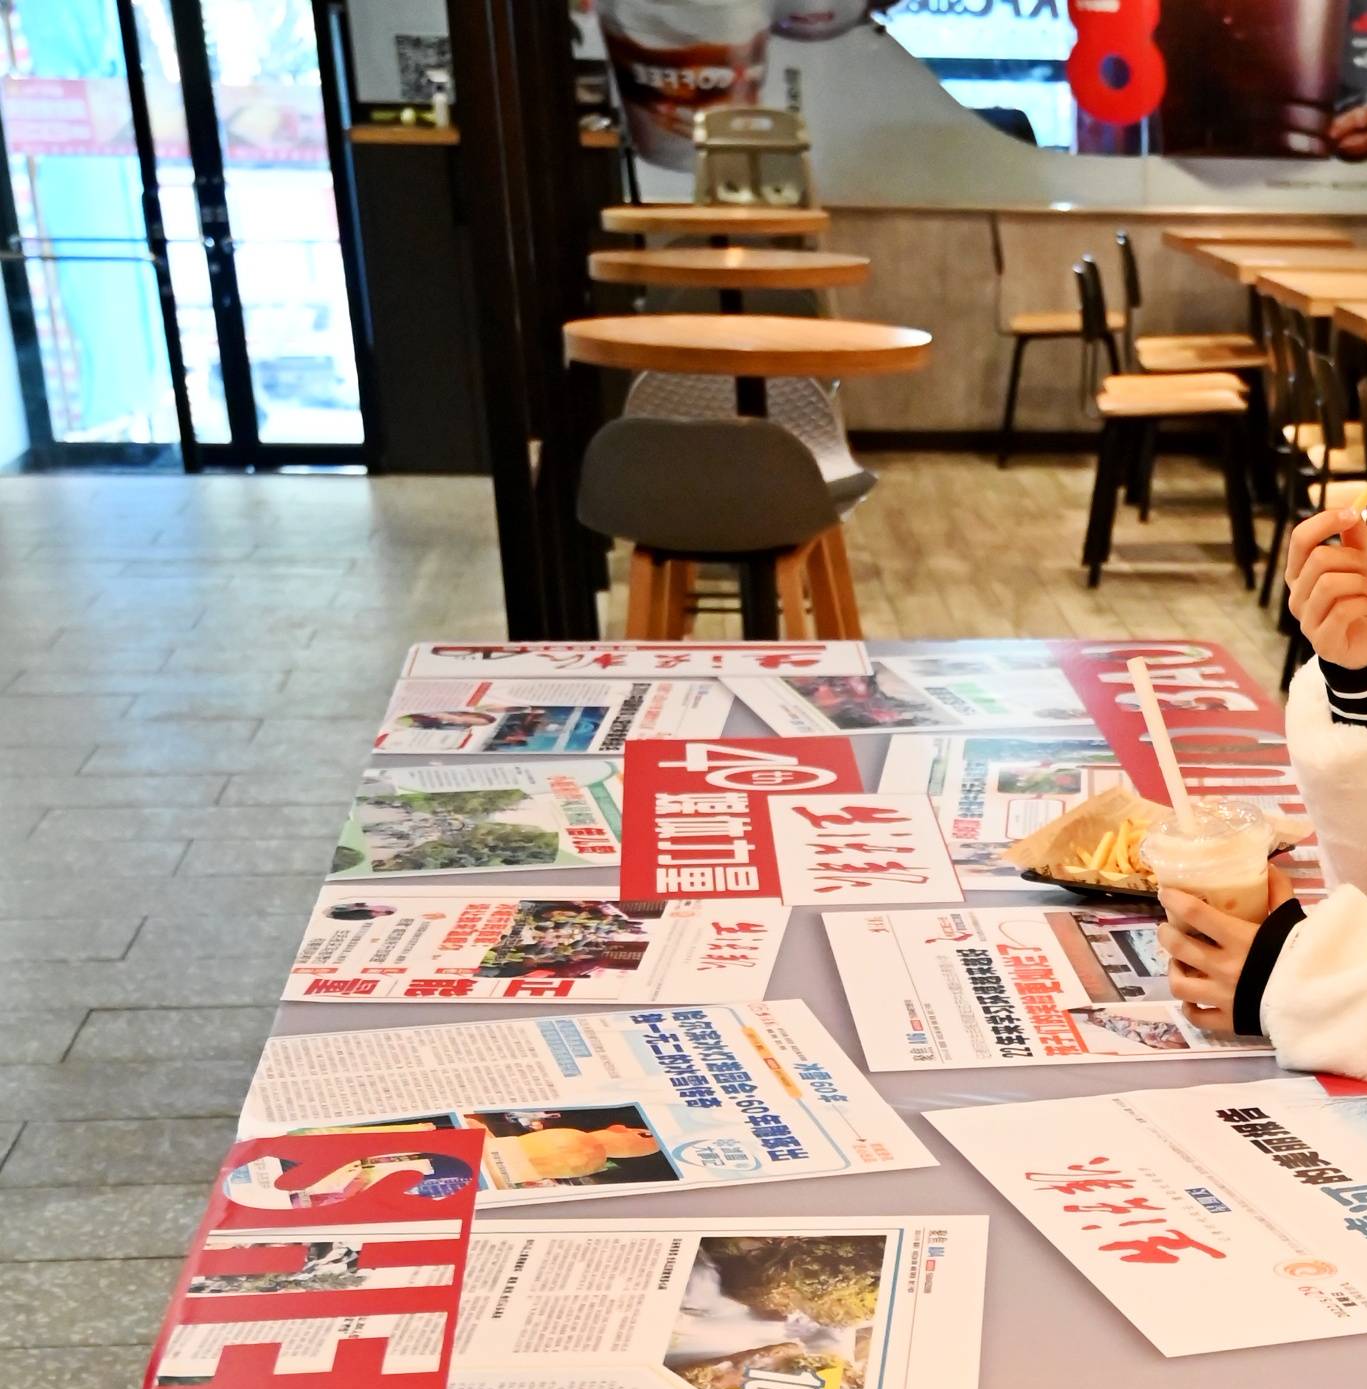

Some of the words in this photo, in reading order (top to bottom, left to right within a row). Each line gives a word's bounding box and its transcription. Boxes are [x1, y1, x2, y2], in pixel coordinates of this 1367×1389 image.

[654, 791, 760, 895] 媒体力量
[305, 978, 576, 999] 正能量
[629, 1012, 721, 1110] 独一无二的冰雪传奇
[671, 1010, 810, 1164] 哈尔滨冰灯游园会:60年雕琢出
[797, 1062, 850, 1105] 冰雪60年
